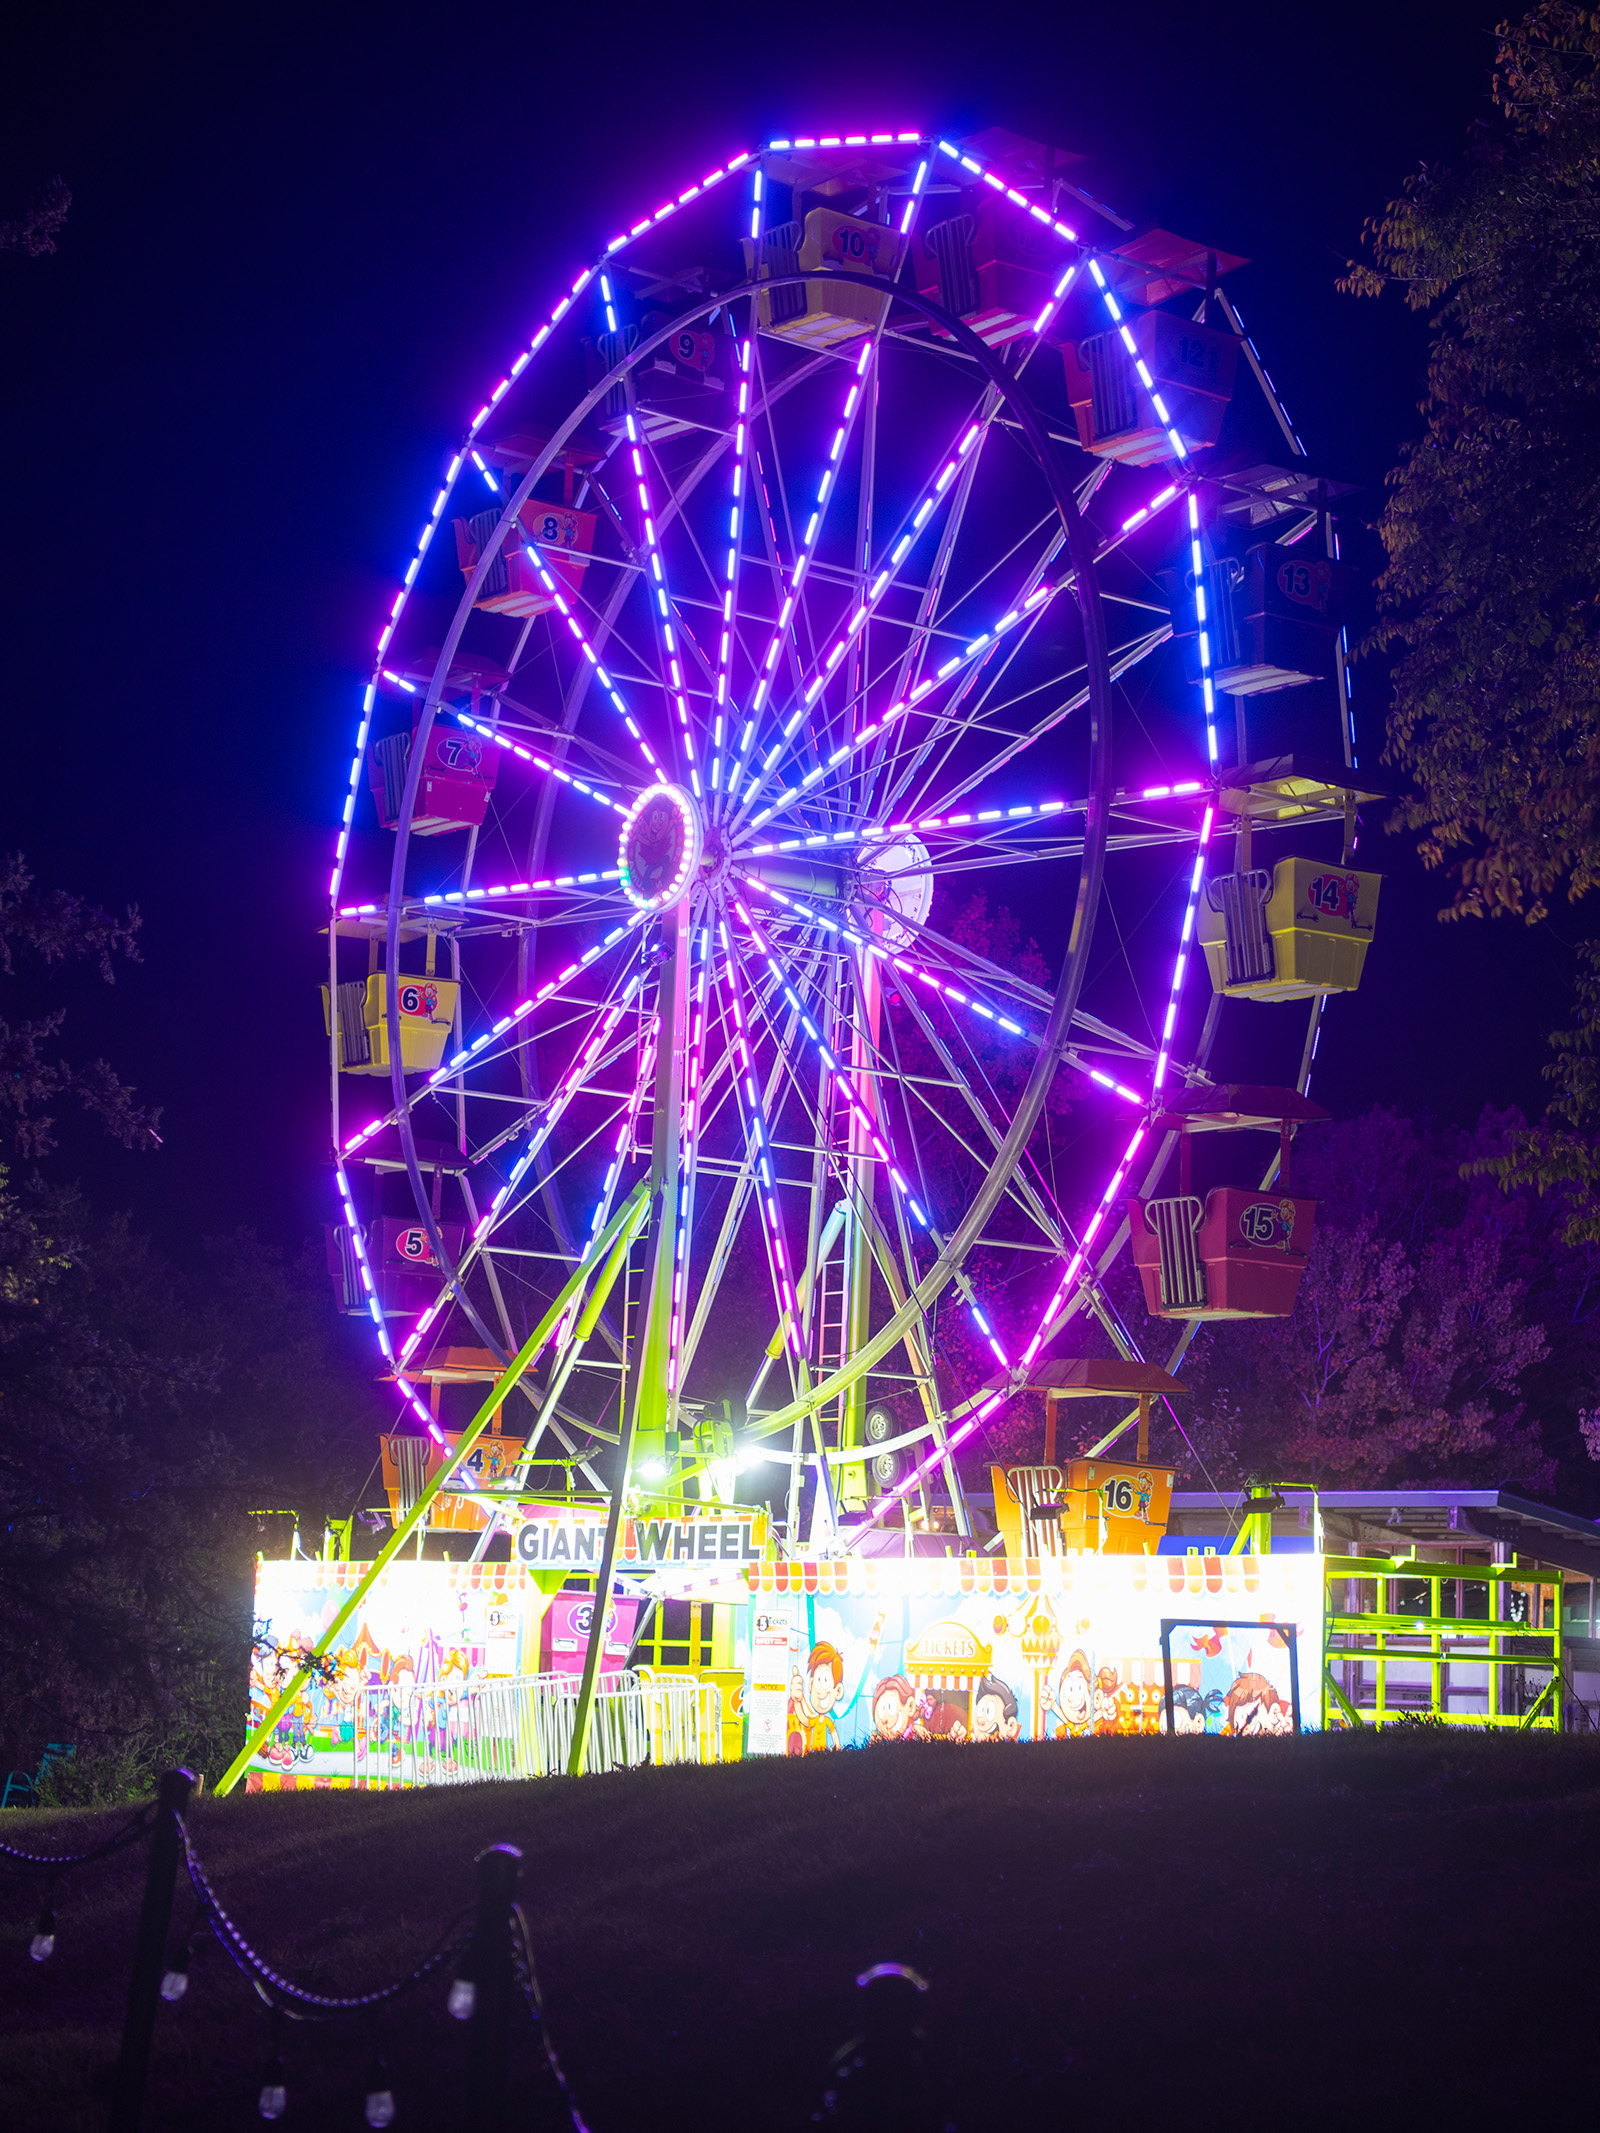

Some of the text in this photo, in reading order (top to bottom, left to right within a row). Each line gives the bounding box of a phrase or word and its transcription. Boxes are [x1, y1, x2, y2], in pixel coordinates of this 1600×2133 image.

[839, 228, 865, 257] 10
[679, 334, 694, 359] 9
[1178, 336, 1205, 369] 12
[542, 516, 558, 541] 8
[1283, 564, 1310, 596] 13
[447, 740, 463, 765] 7
[1311, 877, 1339, 910] 14
[402, 987, 419, 1011] 6
[1244, 1207, 1273, 1240] 15
[406, 1231, 422, 1256] 5
[466, 1448, 484, 1472] 4
[1104, 1479, 1132, 1510] 16
[636, 1521, 761, 1562] WHEEL
[577, 1605, 594, 1631] 3
[924, 1640, 975, 1656] TICKETS
